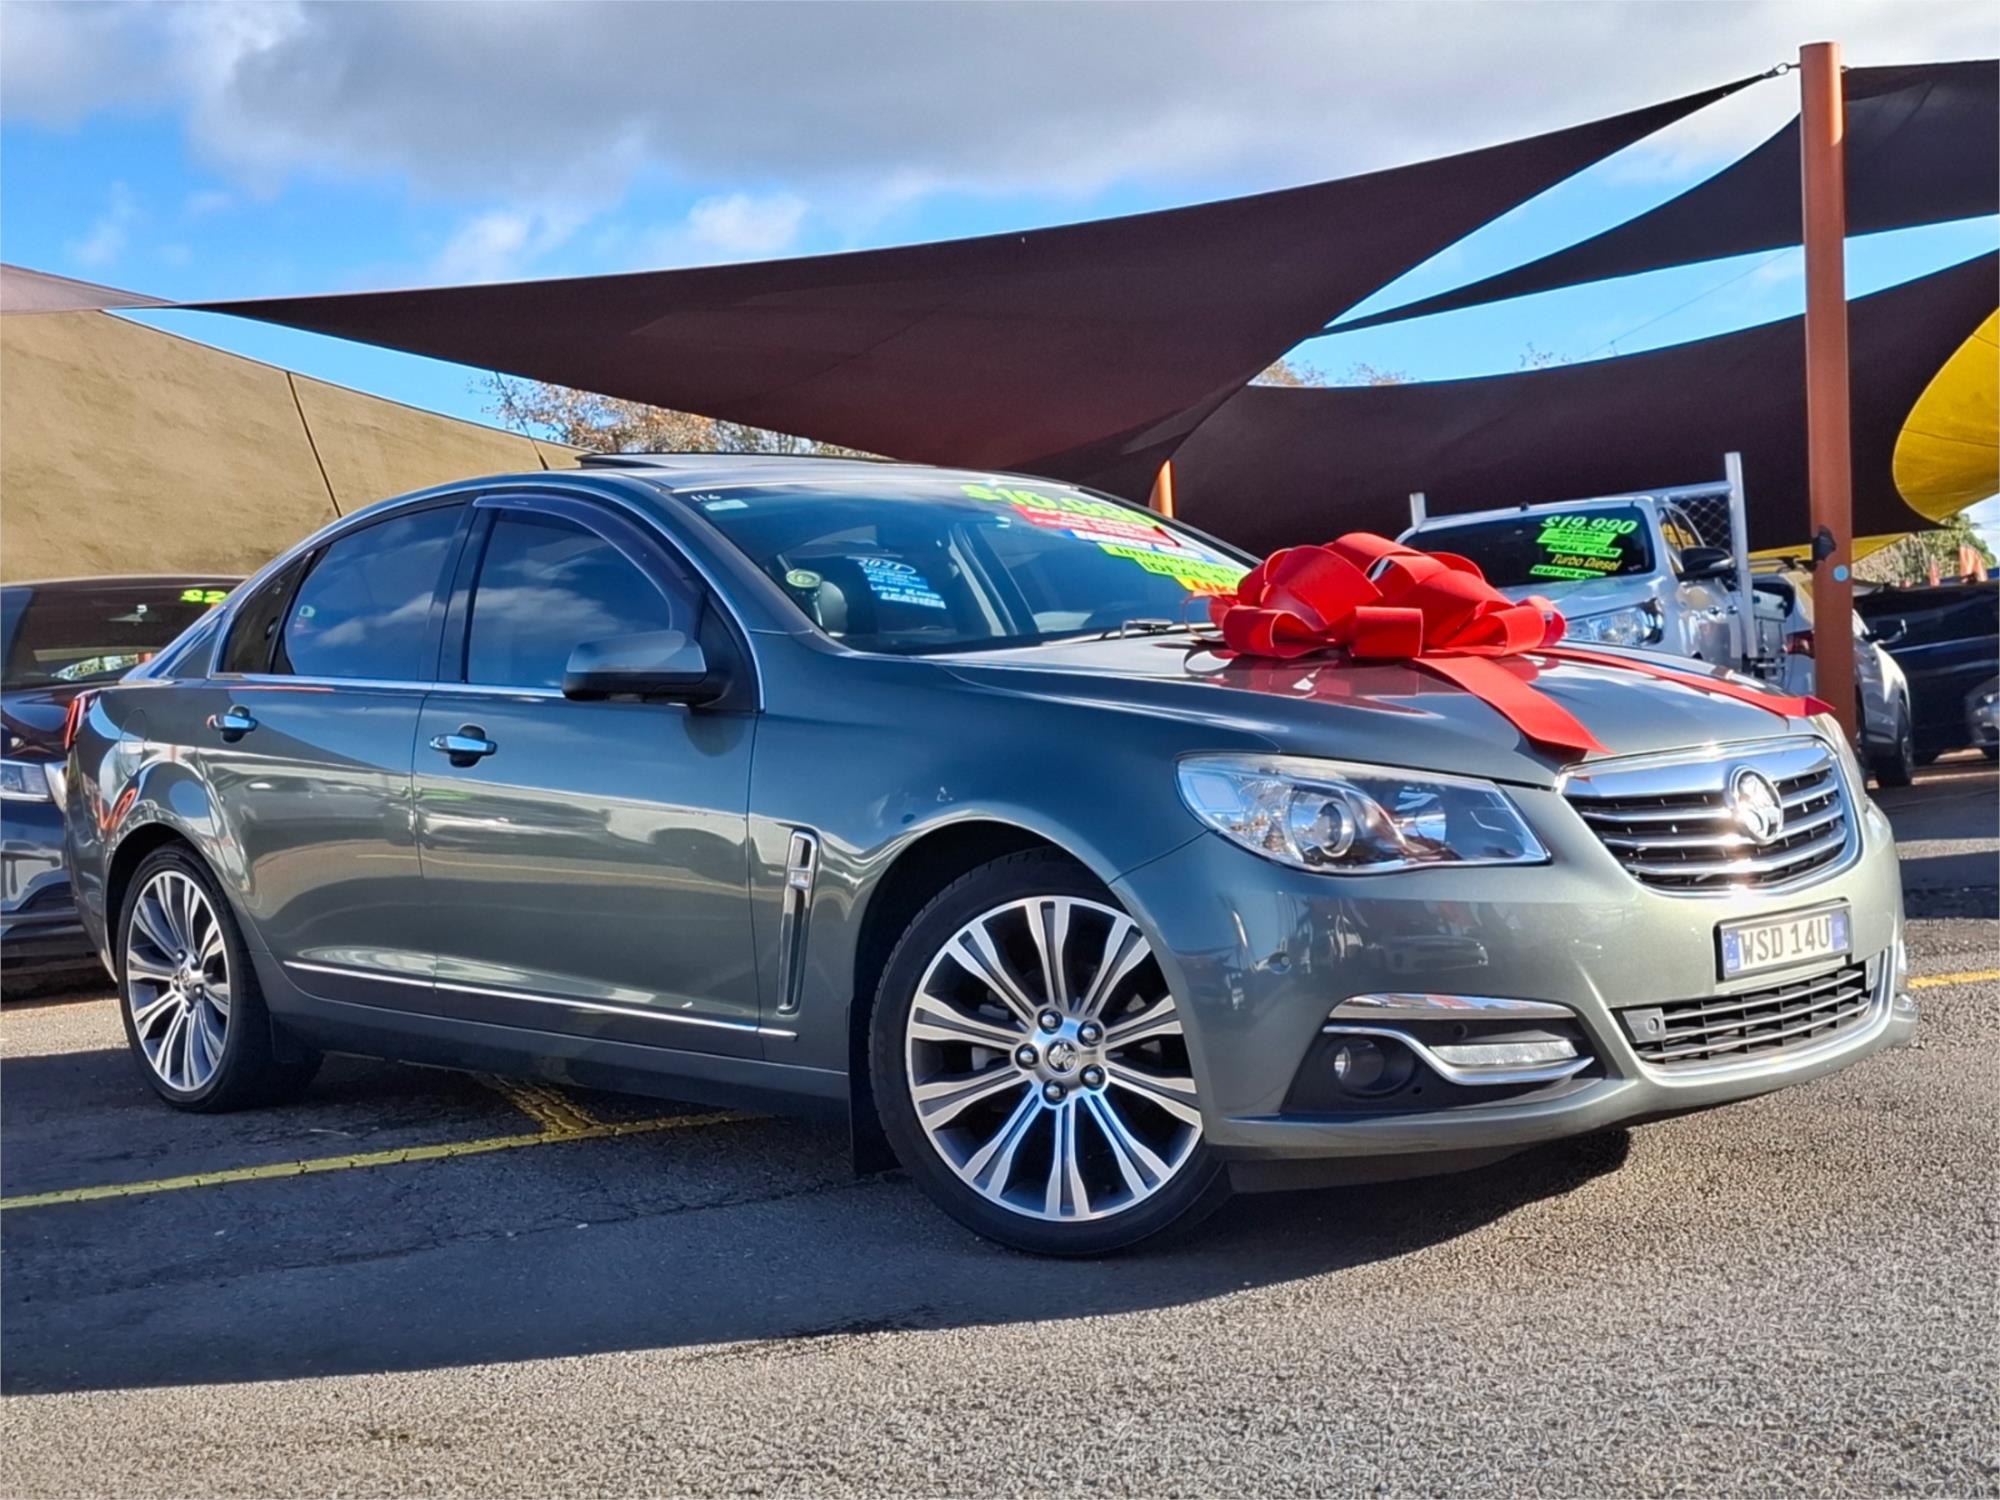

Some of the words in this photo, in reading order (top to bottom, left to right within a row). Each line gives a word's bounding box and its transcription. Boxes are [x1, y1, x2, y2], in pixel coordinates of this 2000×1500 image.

[1551, 554, 1584, 566] Turbo
[1583, 557, 1622, 571] Diesel
[1739, 927, 1784, 965] WSD
[1791, 917, 1830, 954] 14U
